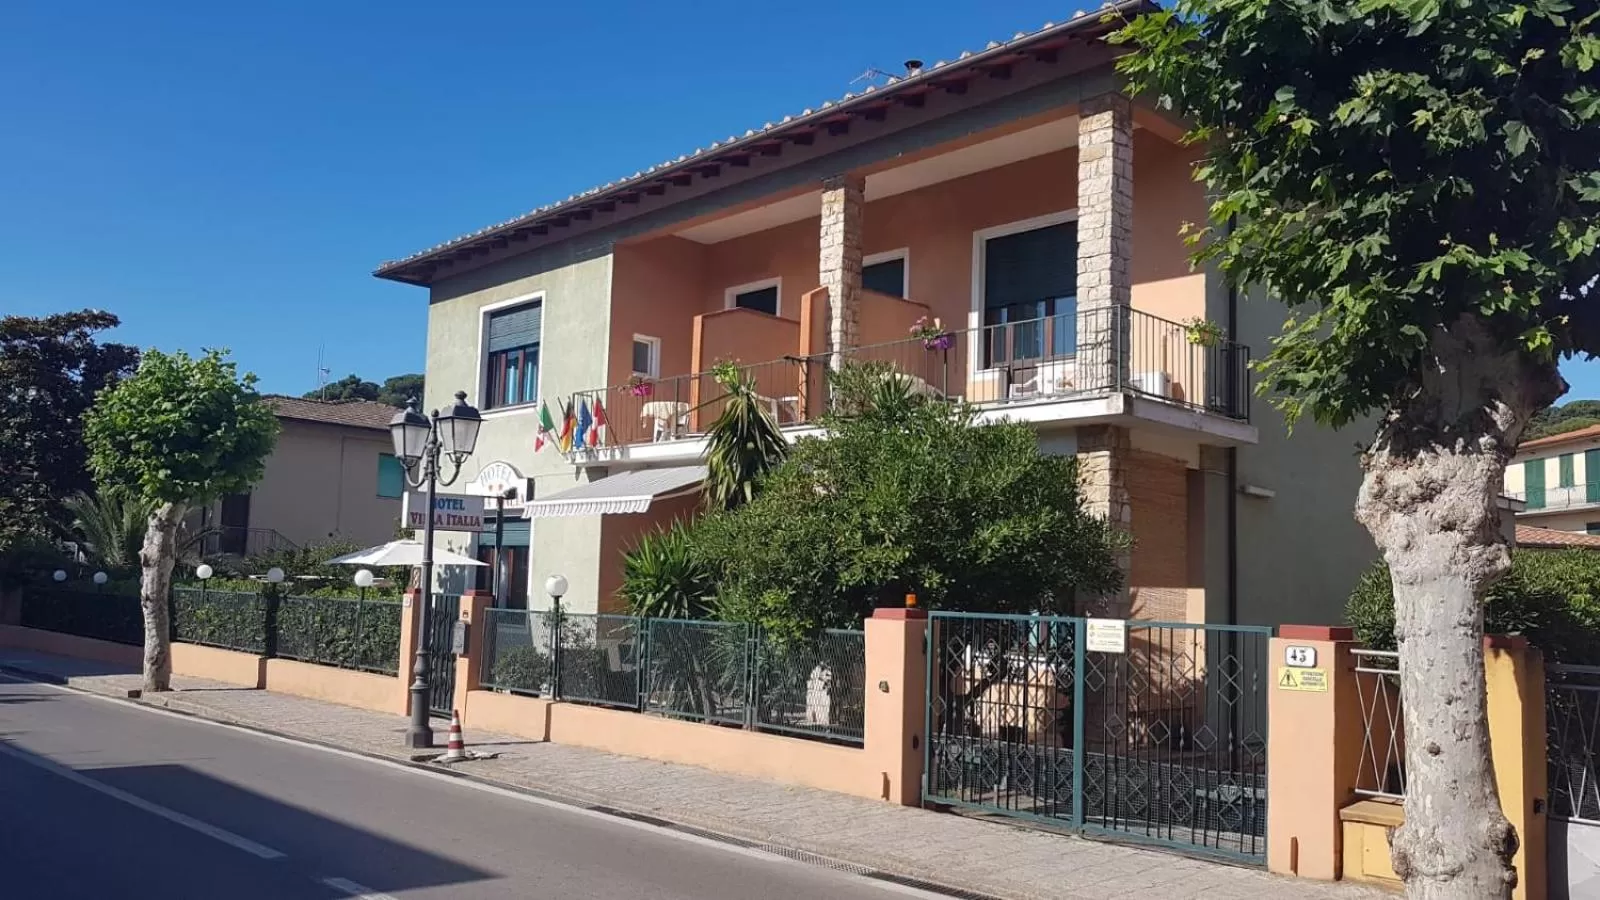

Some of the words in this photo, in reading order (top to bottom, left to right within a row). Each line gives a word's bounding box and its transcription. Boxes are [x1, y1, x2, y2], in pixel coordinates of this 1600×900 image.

[481, 464, 511, 486] HOTEL
[410, 512, 443, 526] VIA
[446, 513, 481, 527] ITALIA
